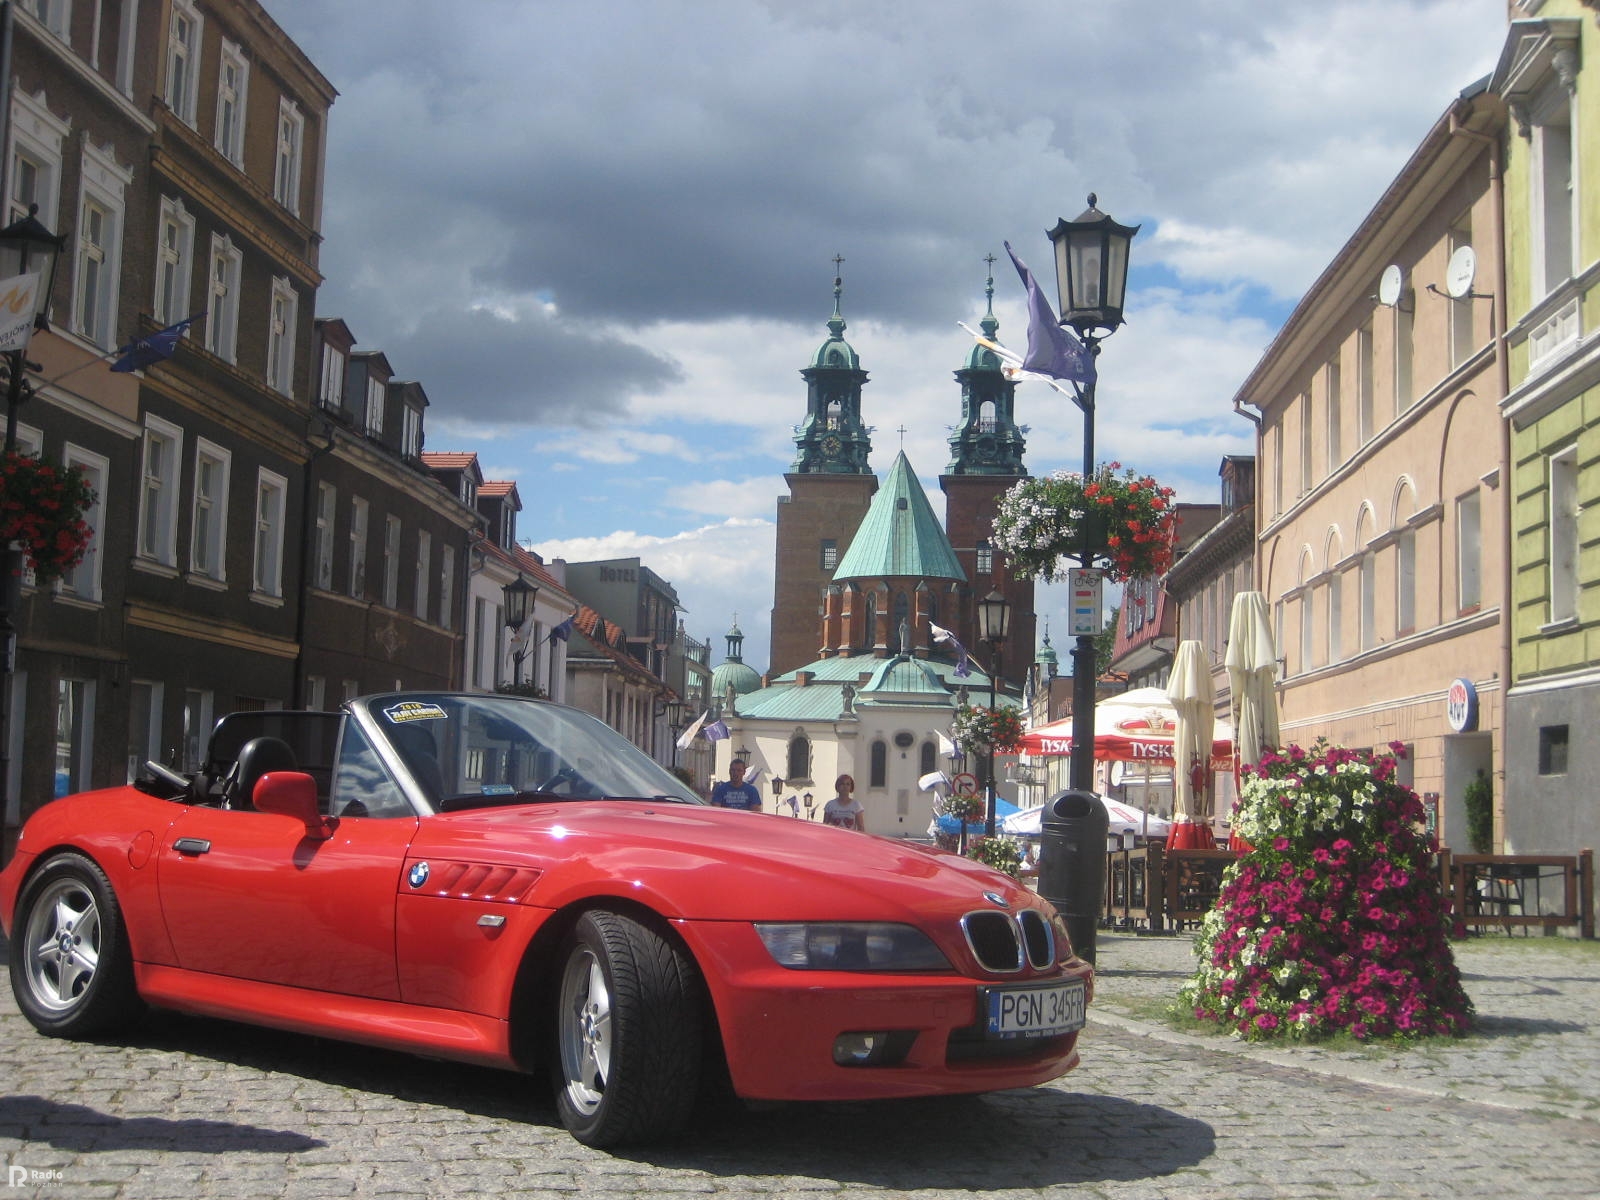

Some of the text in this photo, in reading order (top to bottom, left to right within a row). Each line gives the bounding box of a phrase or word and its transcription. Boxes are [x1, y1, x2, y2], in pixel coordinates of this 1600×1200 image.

[600, 565, 638, 583] HOTEL
[1041, 738, 1072, 752] TYSK
[1001, 986, 1084, 1028] PGN 345FR
